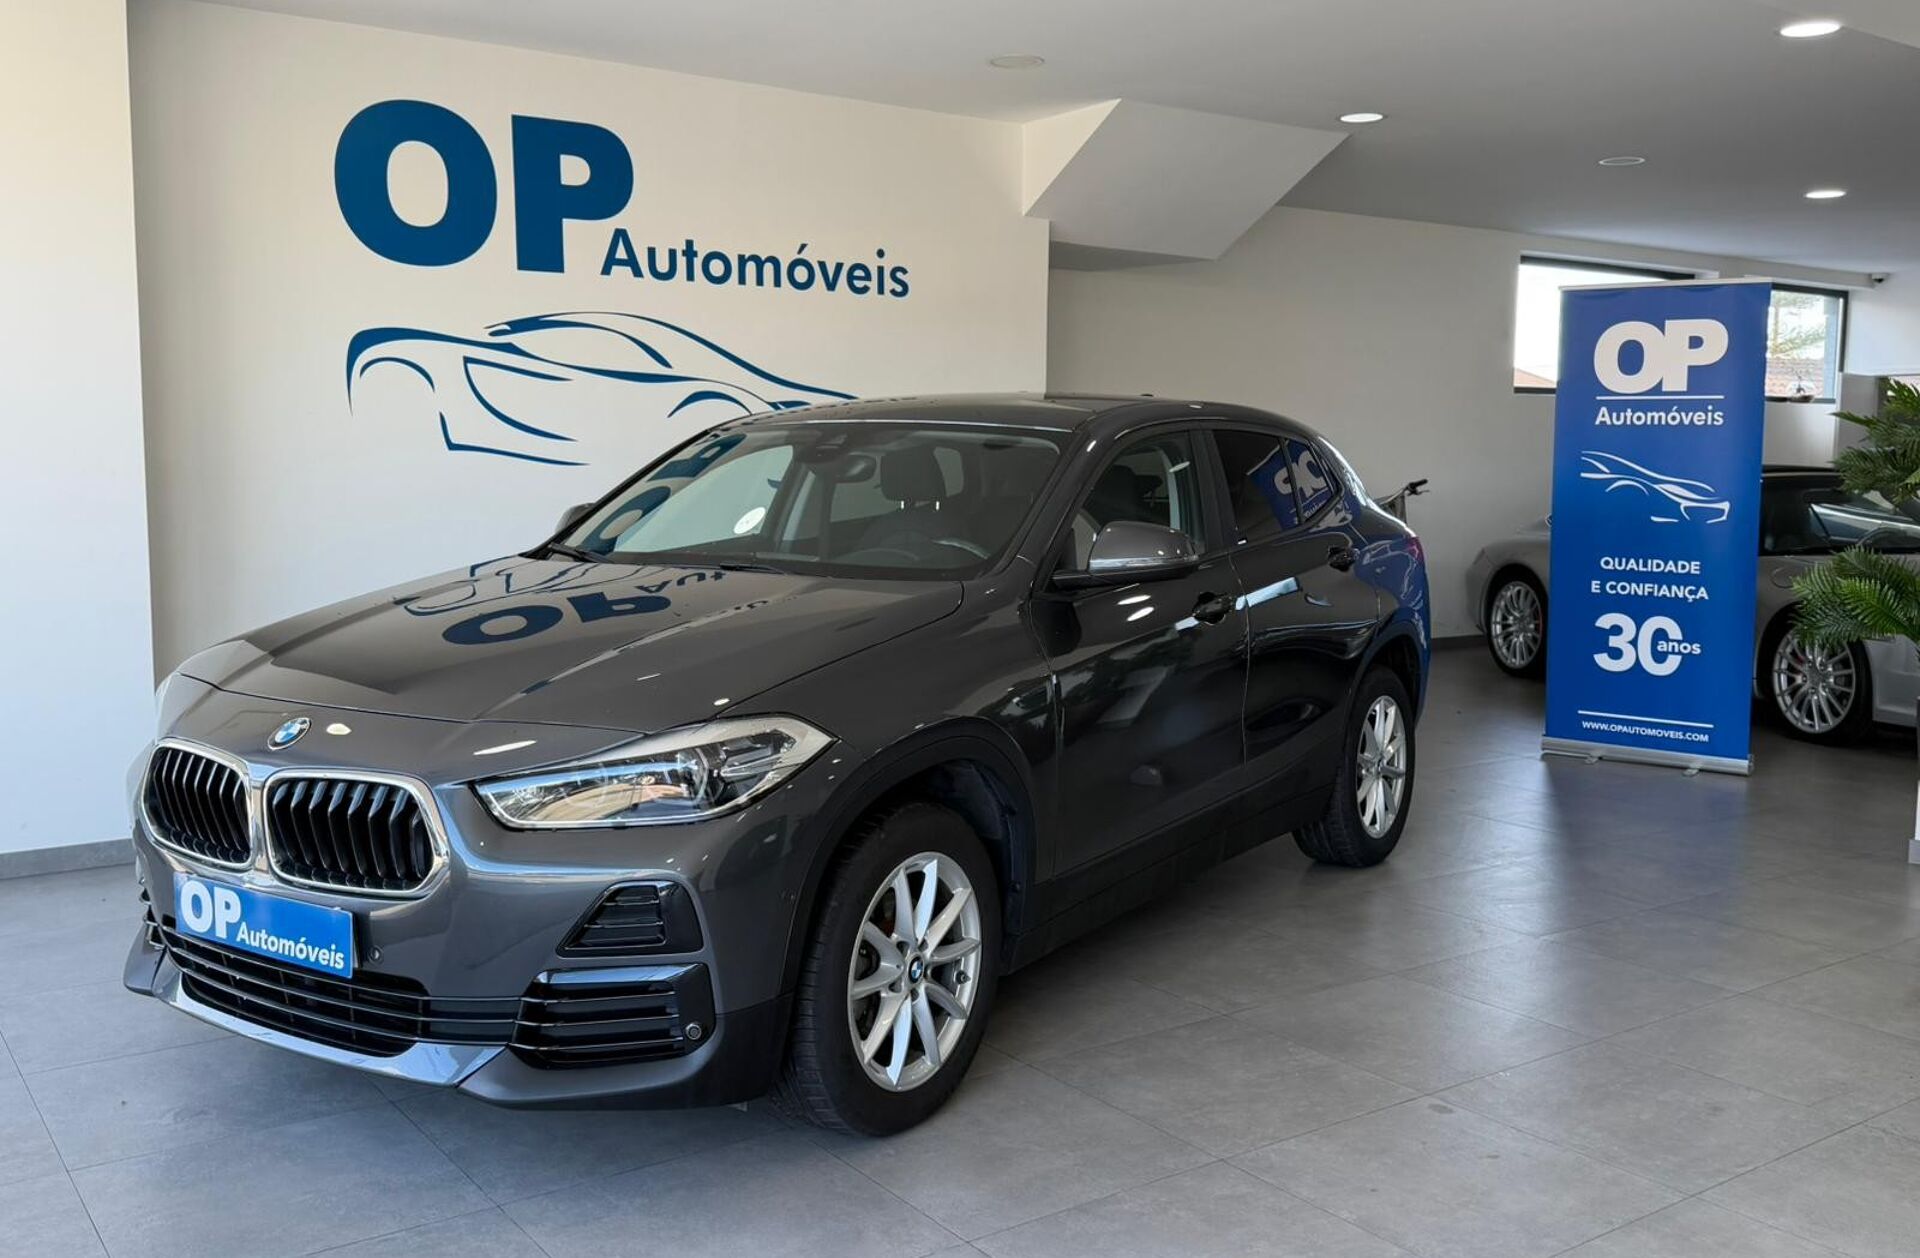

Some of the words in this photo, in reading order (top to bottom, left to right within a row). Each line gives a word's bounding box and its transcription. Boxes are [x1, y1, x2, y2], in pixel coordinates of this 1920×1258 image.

[334, 99, 634, 273] OP
[600, 228, 910, 298] Automóveis
[1593, 319, 1729, 394] OP
[1595, 405, 1724, 426] Automóveis
[1591, 581, 1601, 594] E
[1605, 581, 1709, 602] CONFIANÇA
[1600, 556, 1701, 575] QUALIDADE
[1593, 612, 1683, 677] 30
[1657, 638, 1701, 656] anos
[1582, 721, 1709, 742] WWW.OPAUTOMOVEIS.COM
[180, 881, 241, 939] OP
[236, 923, 345, 969] Automóveis
